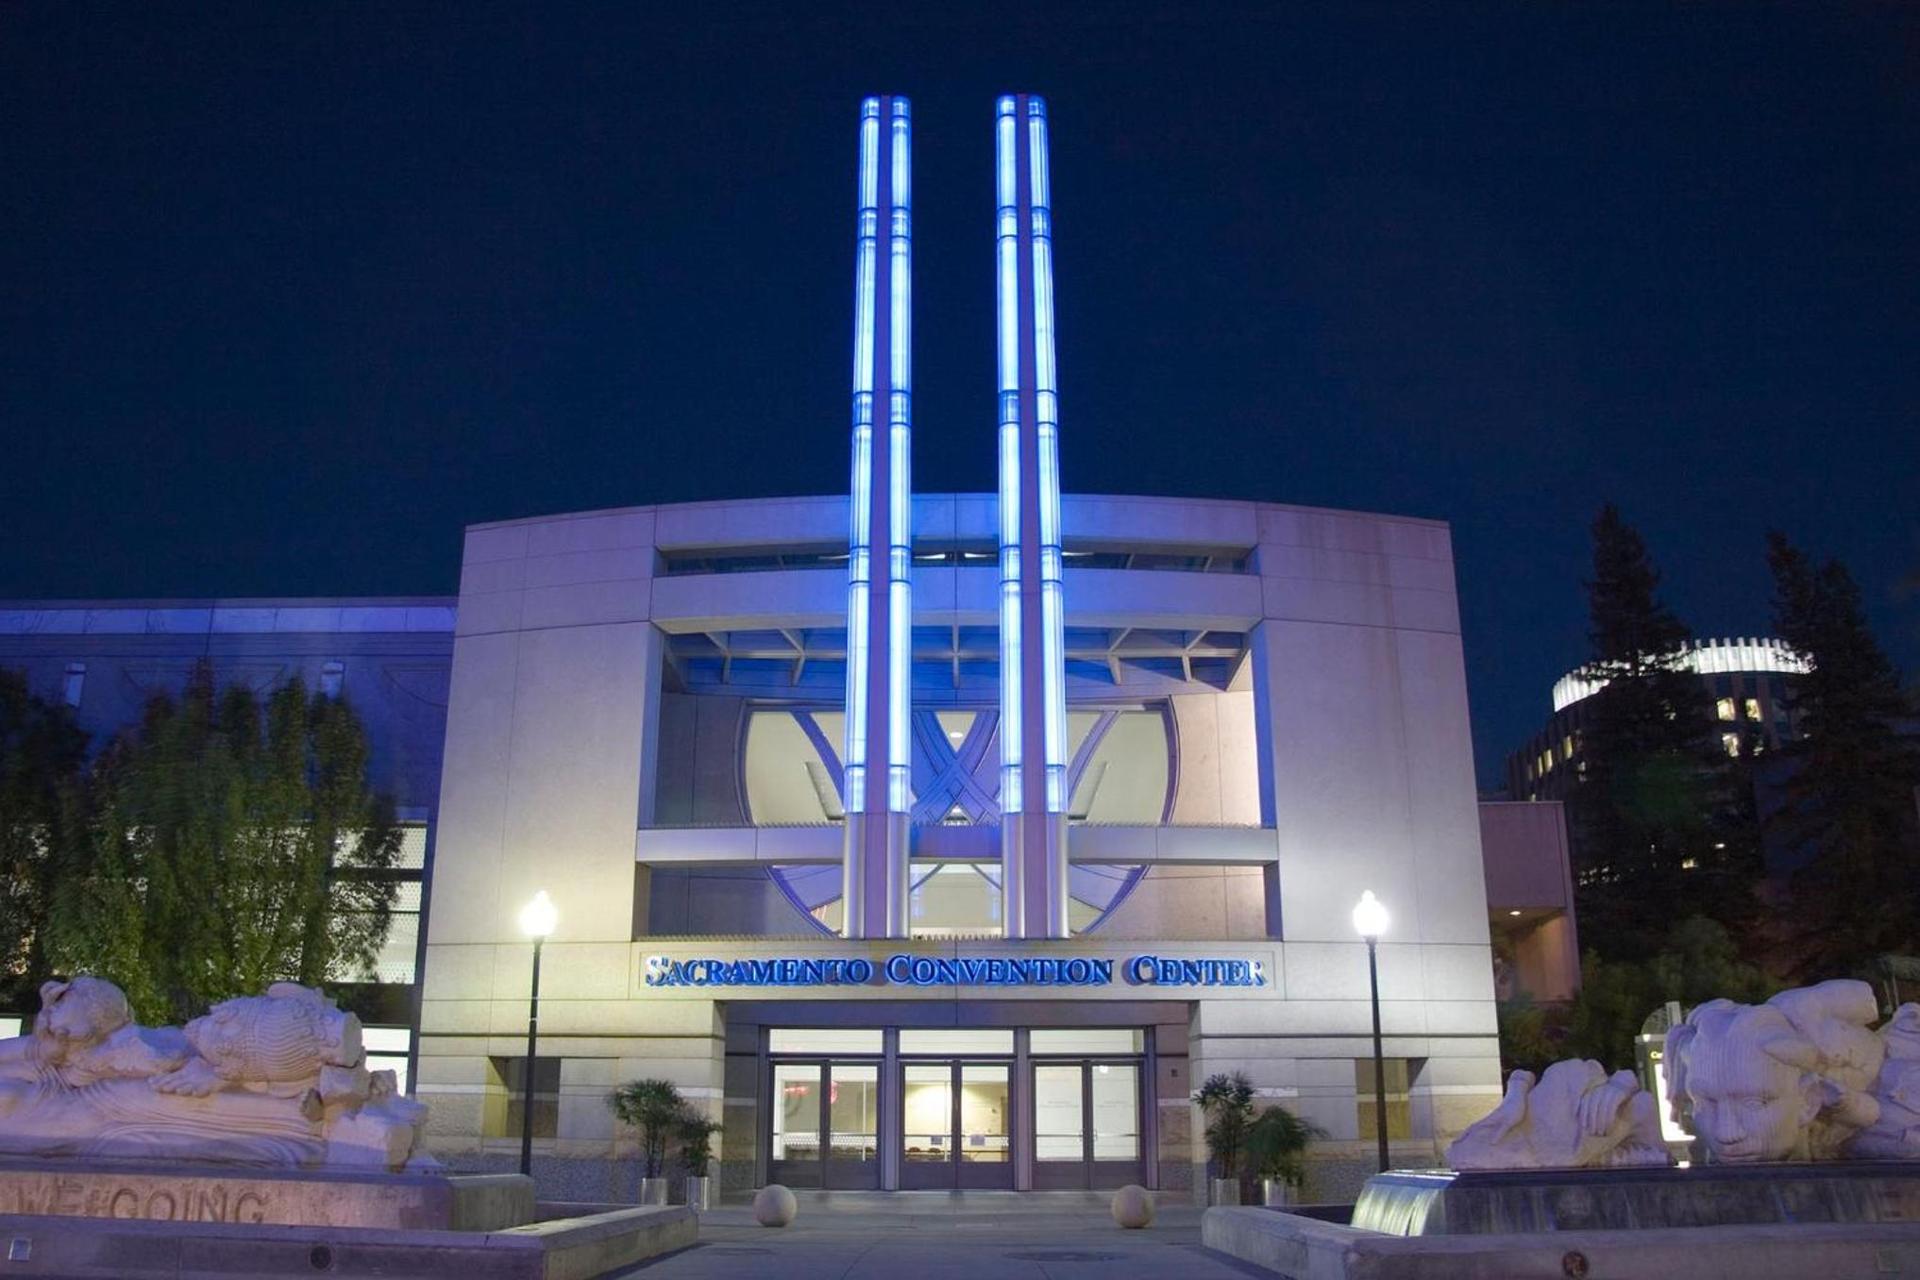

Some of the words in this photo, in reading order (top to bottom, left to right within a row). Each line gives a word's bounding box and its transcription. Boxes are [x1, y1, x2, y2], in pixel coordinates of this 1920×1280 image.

[645, 955, 874, 986] SACRAMENTO
[885, 954, 1115, 985] CONVENTION
[1130, 955, 1267, 986] CENTER
[110, 1186, 266, 1223] GOING
